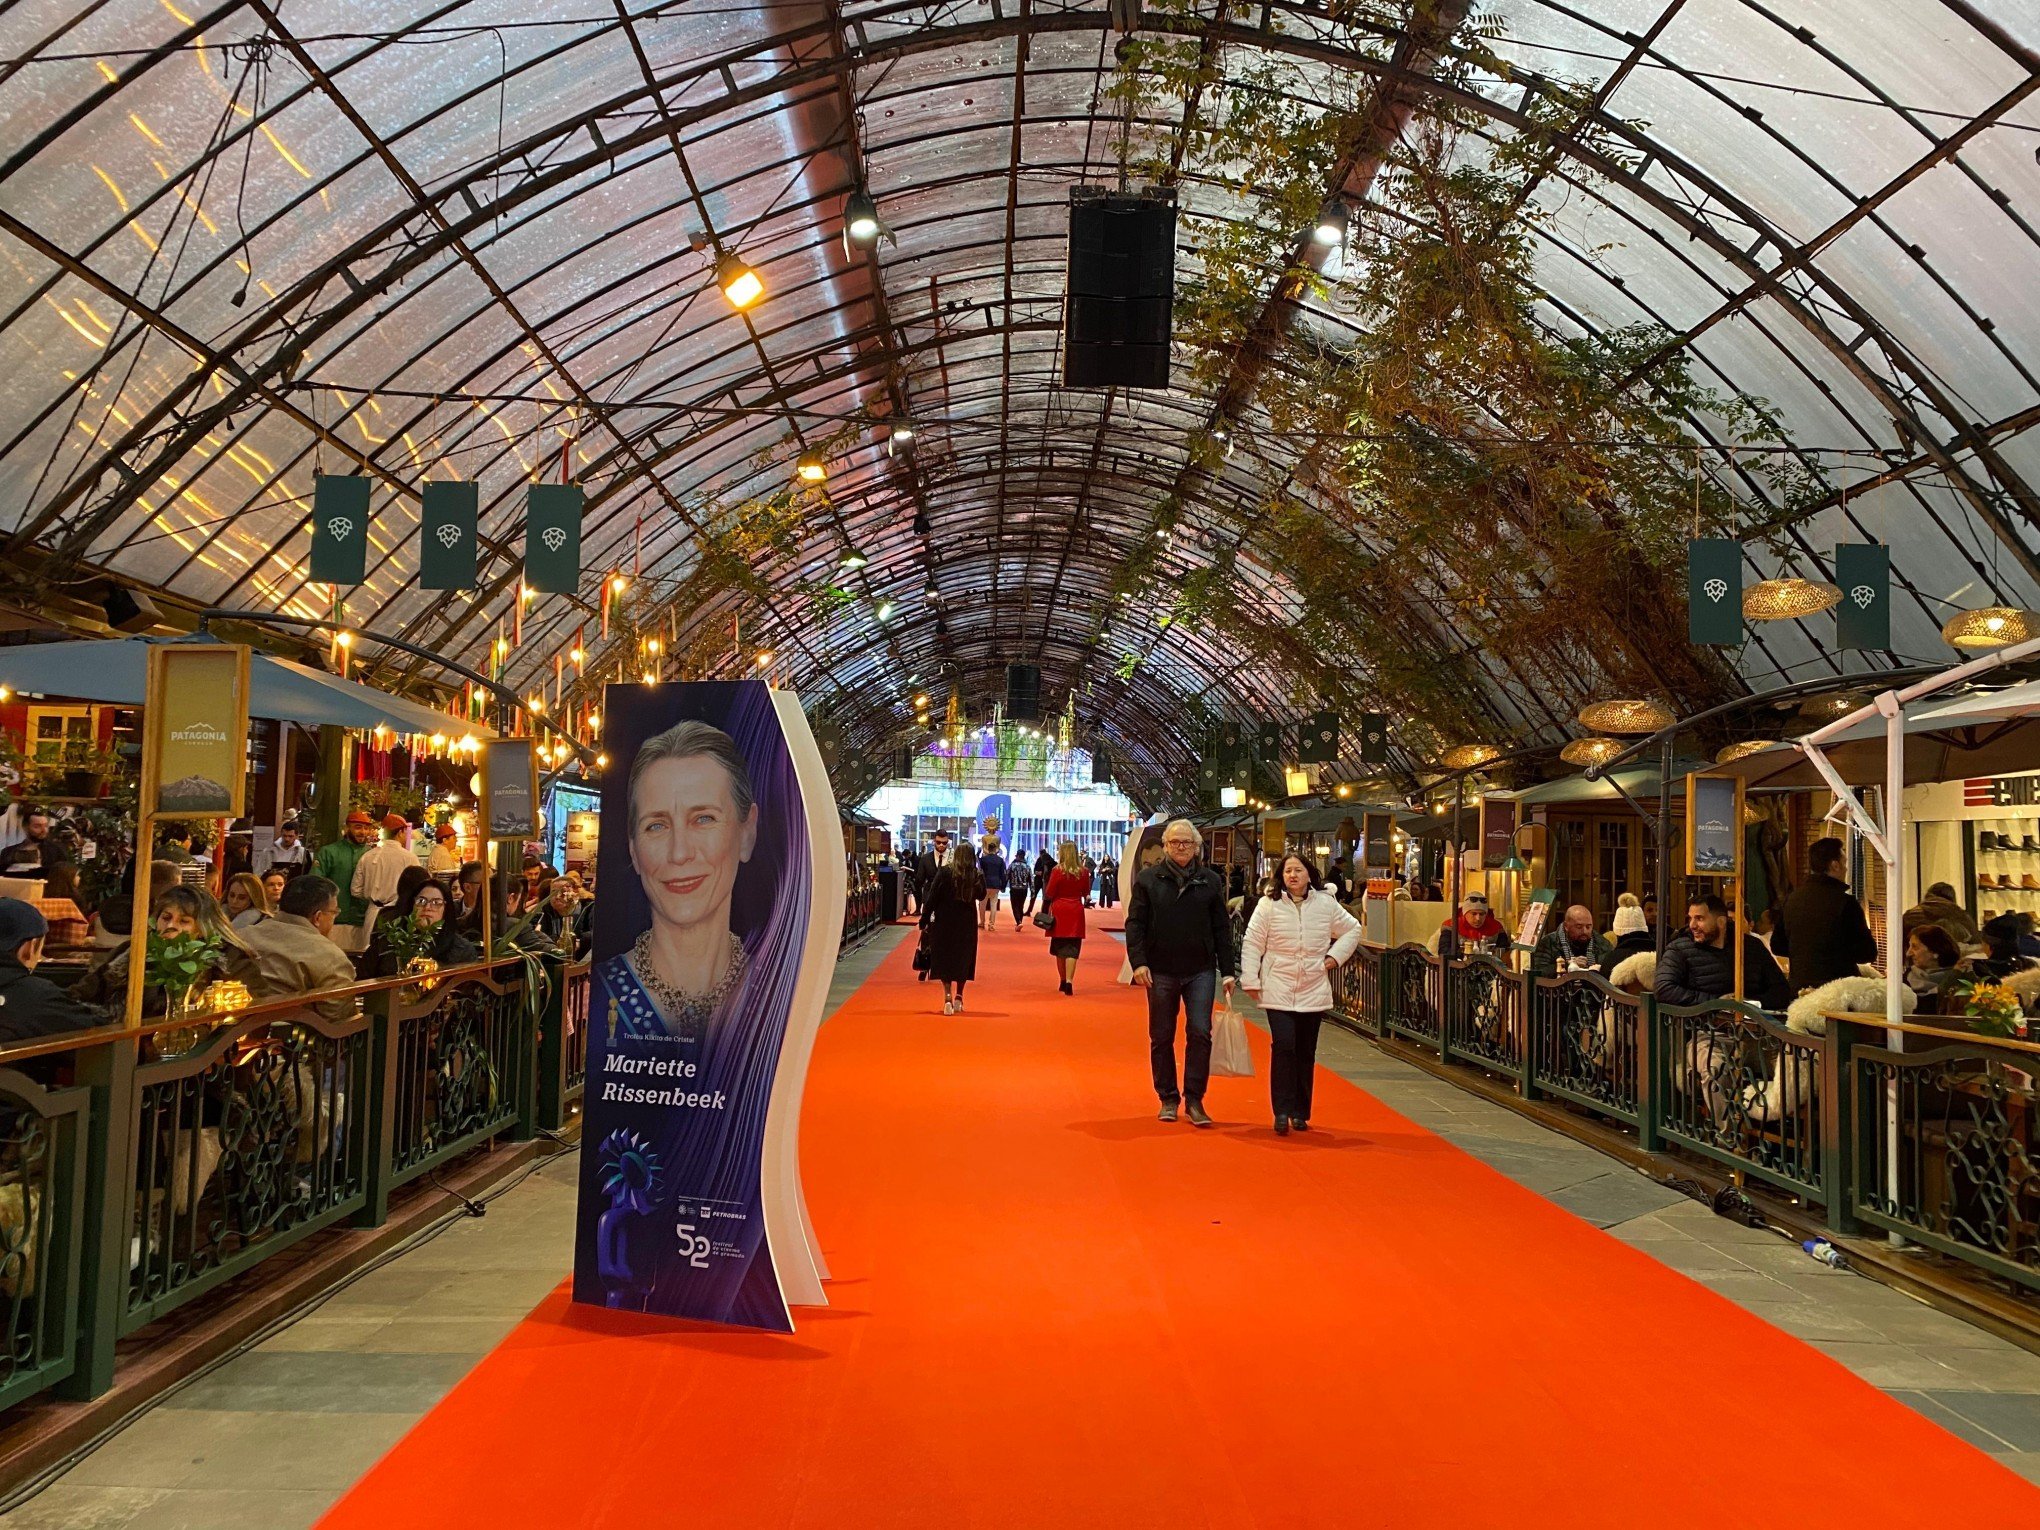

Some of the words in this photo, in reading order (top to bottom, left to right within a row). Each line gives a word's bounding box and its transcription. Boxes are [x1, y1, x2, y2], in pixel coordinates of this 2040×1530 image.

[171, 731, 226, 741] PATAGONIA
[603, 1054, 697, 1078] Mariette
[601, 1082, 726, 1110] Rissenbeek
[712, 1211, 747, 1220] PETROBRAS
[676, 1223, 711, 1269] 52
